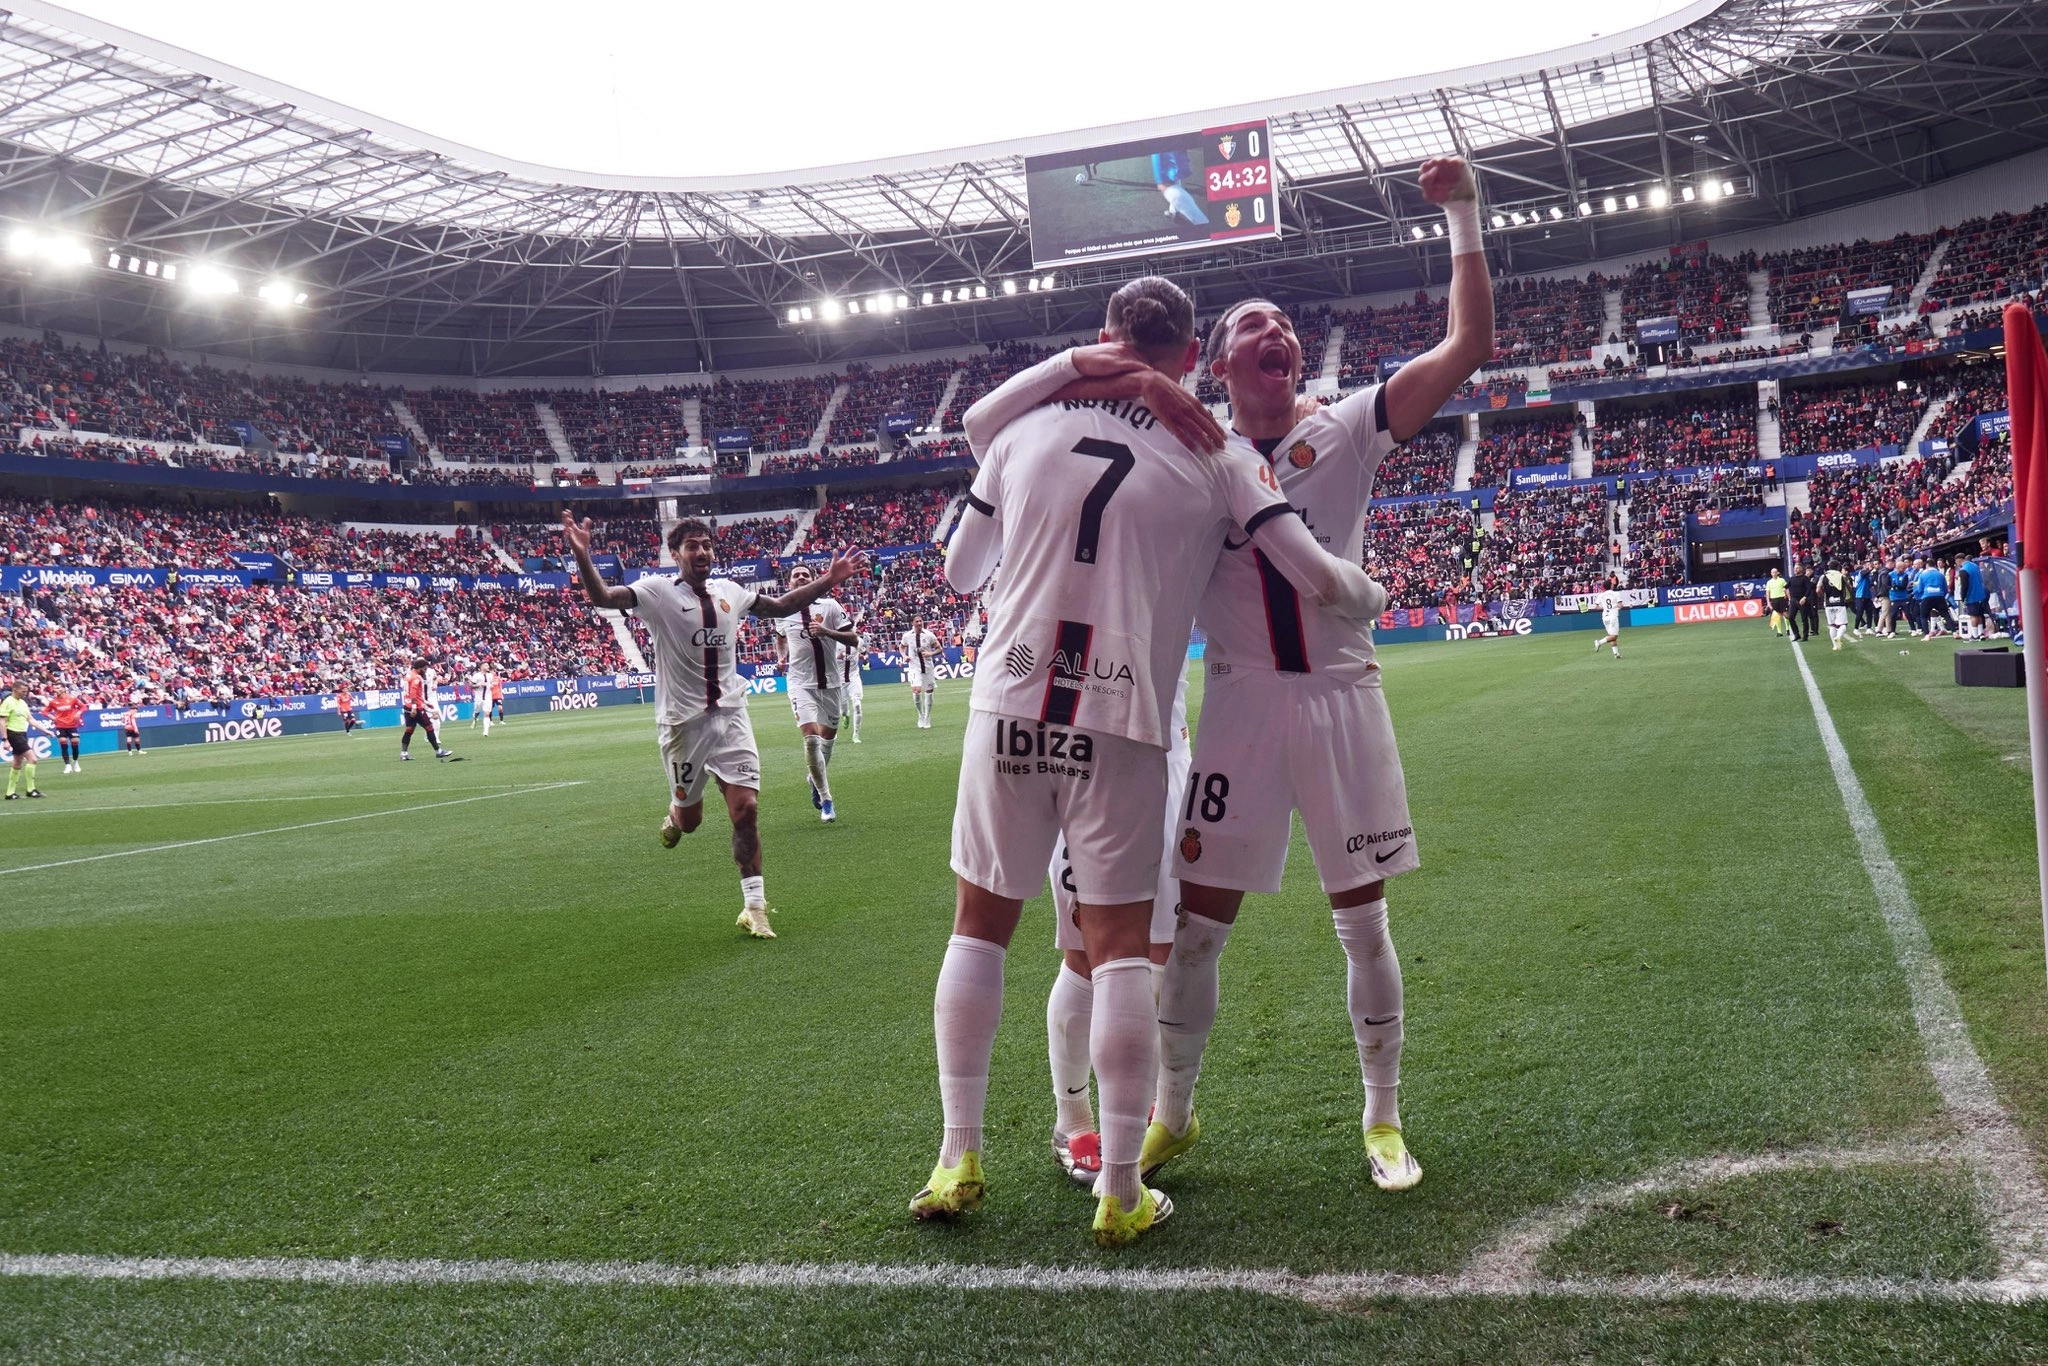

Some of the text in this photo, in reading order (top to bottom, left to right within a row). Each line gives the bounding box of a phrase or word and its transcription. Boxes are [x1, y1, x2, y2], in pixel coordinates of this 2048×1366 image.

[1248, 131, 1260, 157] 0
[1209, 165, 1267, 192] 34:32
[1253, 197, 1265, 223] 0
[1070, 436, 1136, 565] 7
[39, 570, 96, 585] Mobekio
[109, 573, 155, 585] GIMA
[1606, 598, 1613, 610] 8
[1679, 602, 1740, 621] LALIGA
[1446, 618, 1533, 641] move
[1046, 649, 1136, 687] ALUA
[437, 691, 457, 702] Halcó
[521, 684, 546, 694] PAMPLONA
[1054, 676, 1126, 698] HOTELS & RESORTS
[550, 692, 599, 711] moeve
[205, 717, 282, 743] moeve
[996, 719, 1094, 763] Ibiza
[672, 761, 693, 784] 12
[997, 760, 1090, 780] Illes Balears
[1185, 772, 1229, 822] 18
